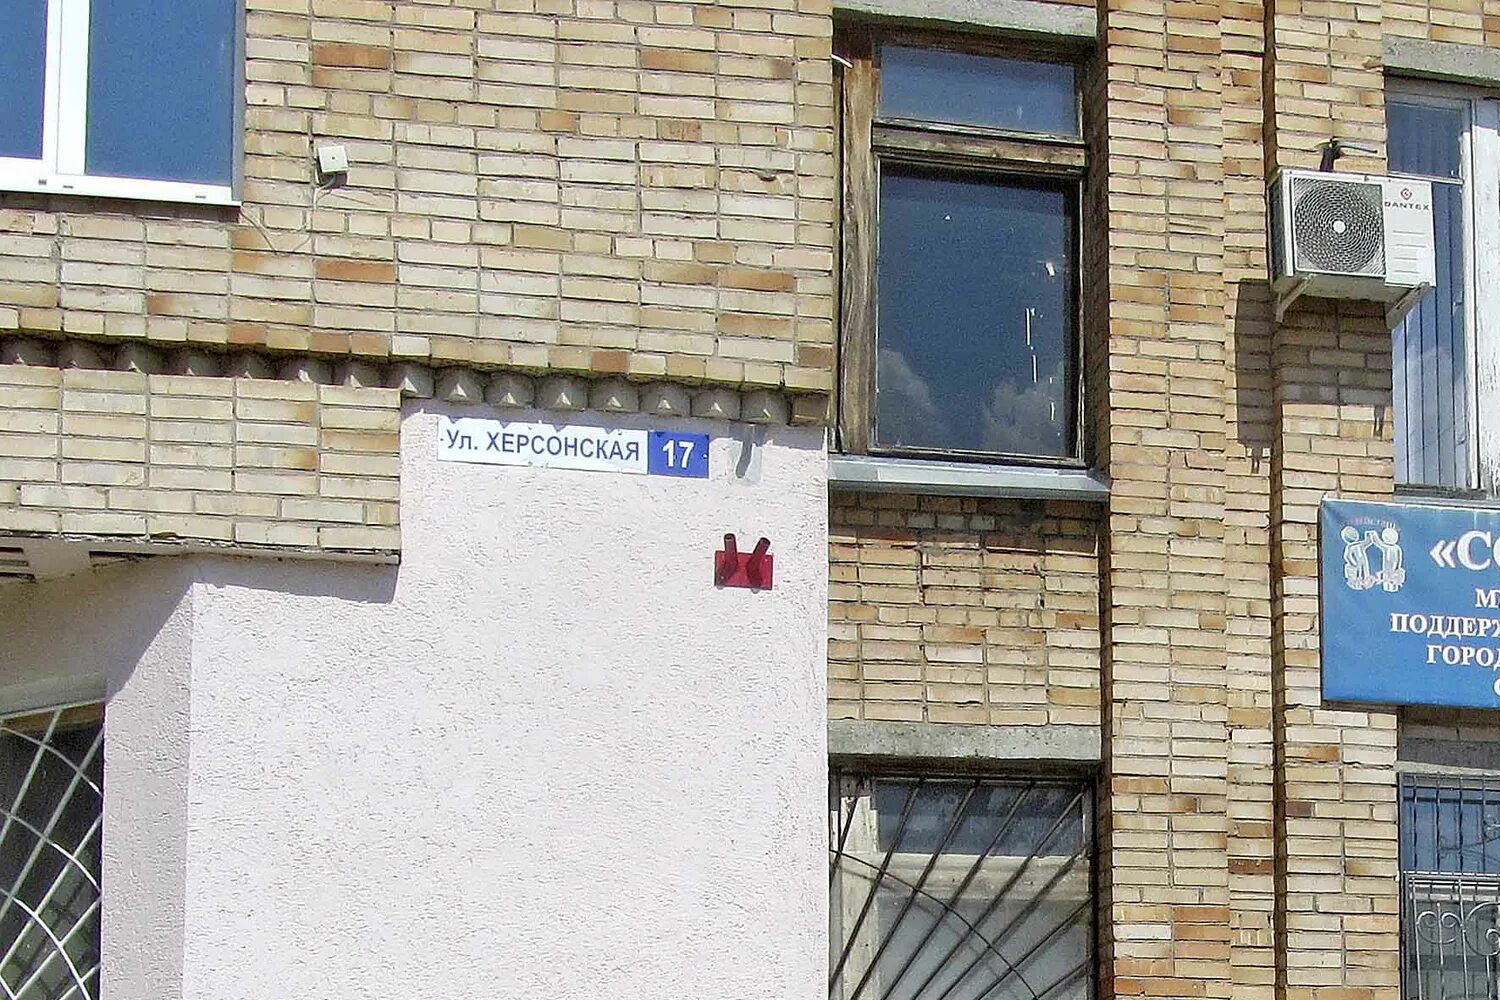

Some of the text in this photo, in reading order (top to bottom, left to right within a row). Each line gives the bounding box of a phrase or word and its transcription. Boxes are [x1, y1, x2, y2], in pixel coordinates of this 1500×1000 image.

[1384, 200, 1430, 211] DANTEX
[445, 429, 640, 461] Ул. ХЕРСОНСКАЯ
[662, 440, 695, 468] 17
